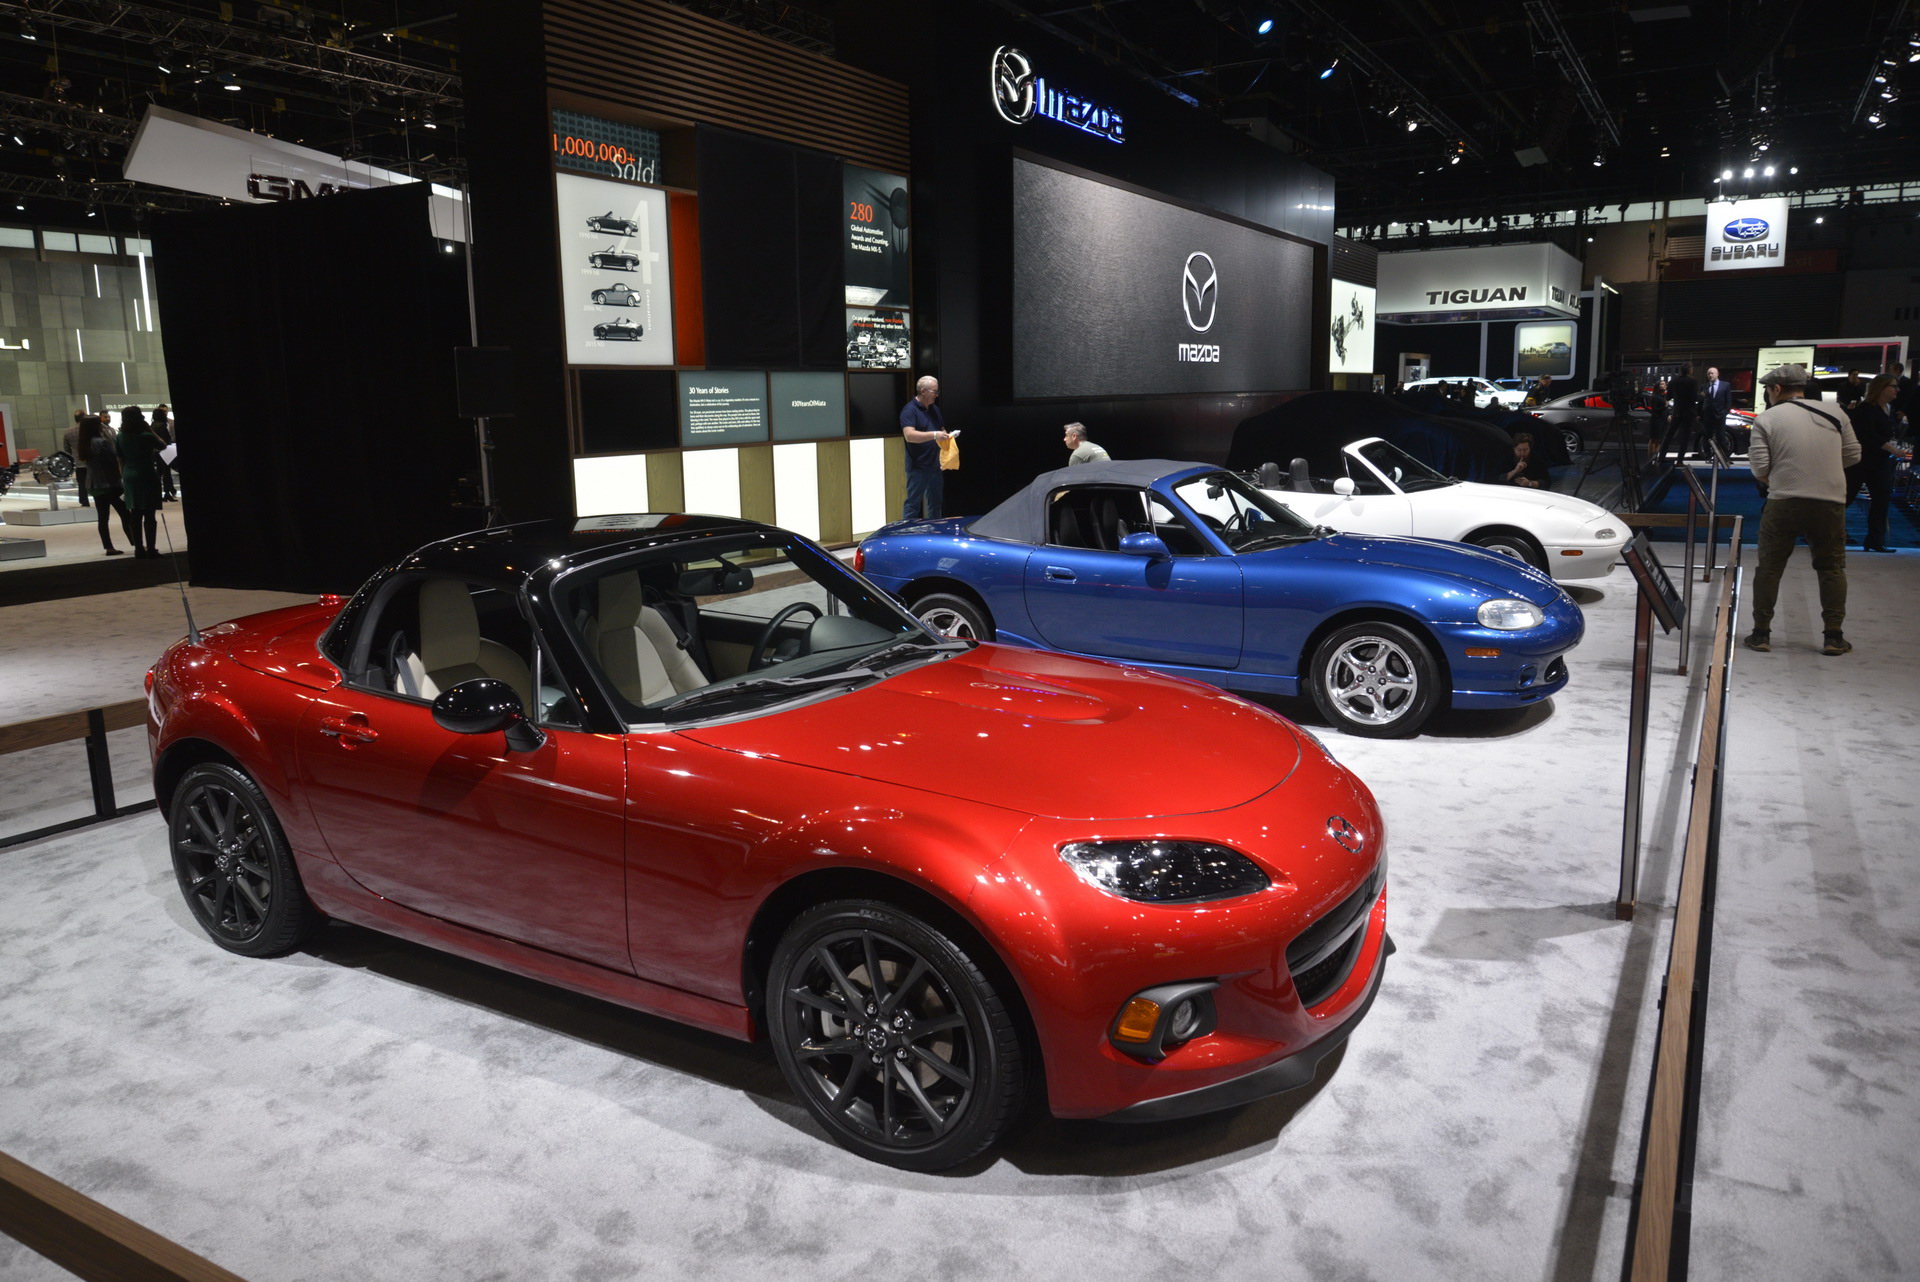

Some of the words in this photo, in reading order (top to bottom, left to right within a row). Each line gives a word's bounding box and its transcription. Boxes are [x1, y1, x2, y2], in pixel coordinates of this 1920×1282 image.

[553, 133, 636, 165] 1,000,000+
[611, 153, 655, 184] Sold
[247, 173, 362, 200] GM
[850, 201, 873, 223] 280
[850, 224, 863, 232] Global
[863, 227, 884, 236] Automotive
[851, 233, 864, 241] Awards
[615, 200, 659, 284] 4
[858, 243, 870, 252] Mazda
[1711, 243, 1779, 255] SUBARU
[1426, 287, 1527, 305] TIGUAN
[689, 386, 695, 394] 30
[709, 386, 714, 394] of
[714, 386, 729, 394] Stories
[791, 400, 827, 408] #30YearsOfMiata
